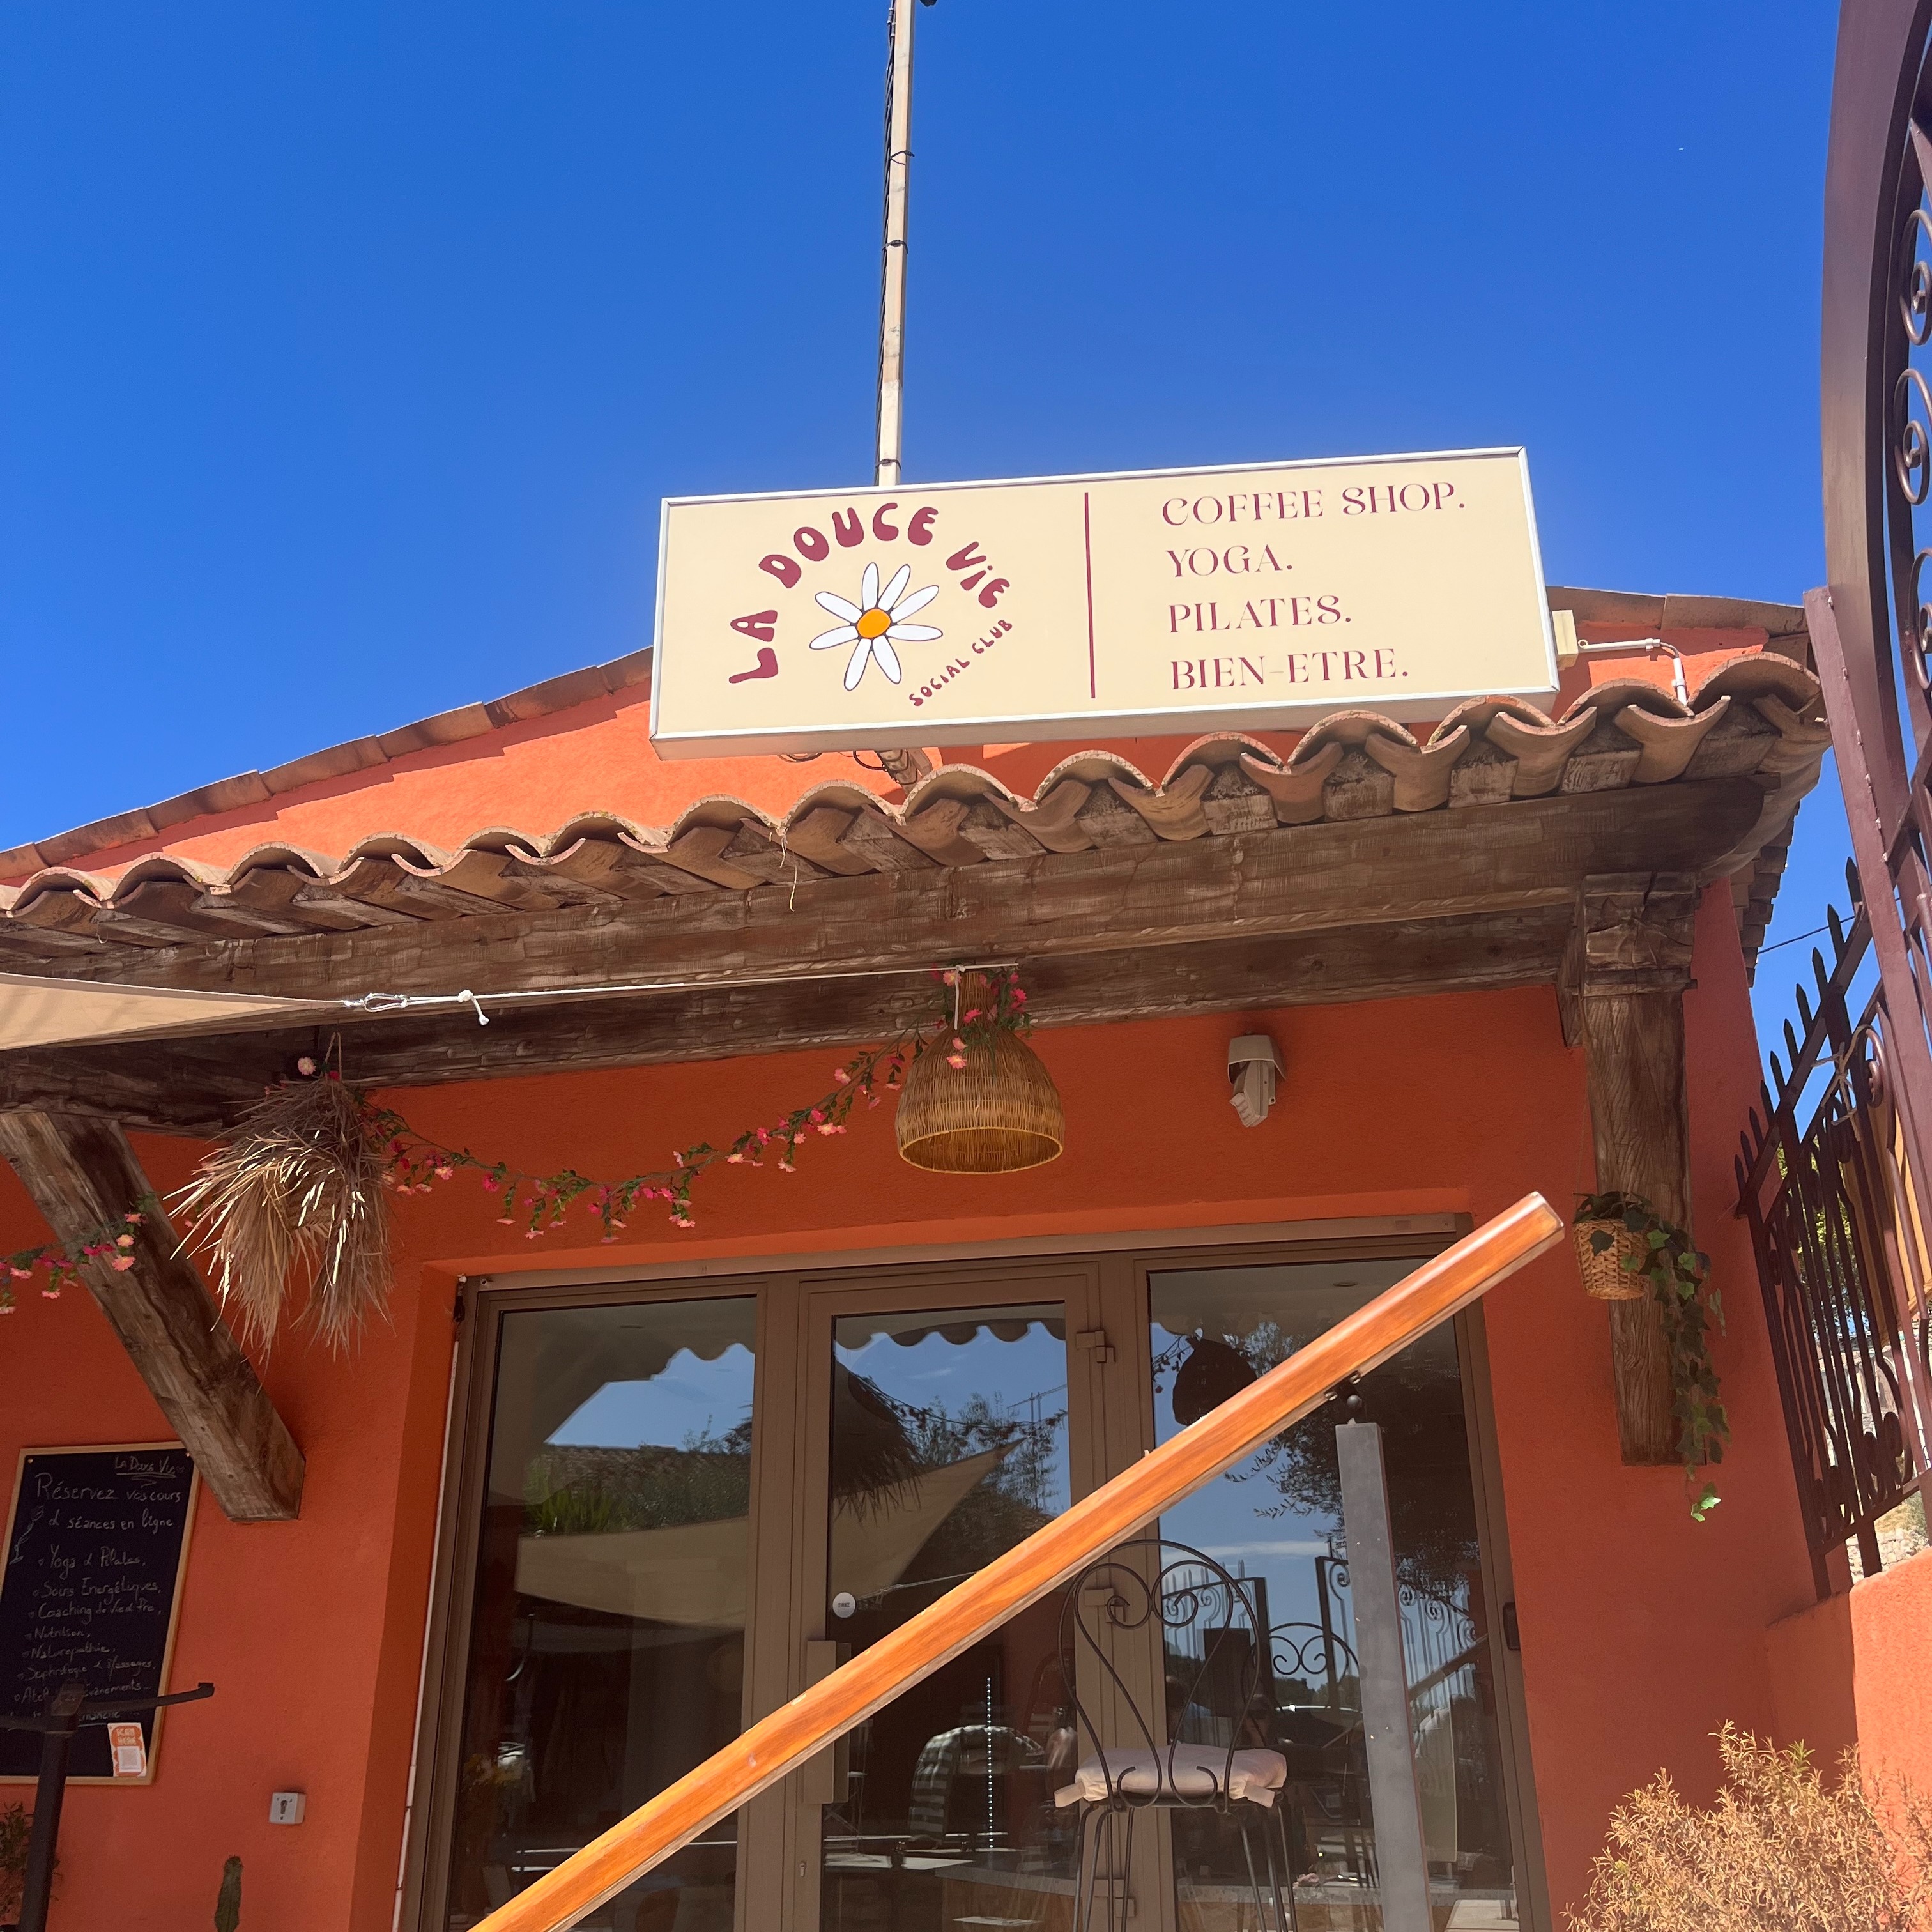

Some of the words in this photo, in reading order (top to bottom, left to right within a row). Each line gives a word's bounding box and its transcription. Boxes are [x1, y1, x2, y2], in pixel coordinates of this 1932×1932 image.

[1163, 490, 1324, 526] COFFEE
[1342, 482, 1465, 515] SHOP.
[1165, 544, 1293, 578] YOGA.
[729, 610, 778, 684] LA
[759, 503, 939, 588] DOUCE
[1169, 595, 1351, 633] PILATES.
[909, 659, 970, 706] SOCIAL
[972, 620, 1012, 654] CLUB
[1171, 648, 1408, 690] BIEN-ETRE.
[34, 1472, 118, 1500] Réservez
[127, 1491, 149, 1501] vos
[151, 1490, 181, 1502] cours
[66, 1517, 115, 1529] séances
[141, 1508, 174, 1534] ligne
[50, 1544, 76, 1581] Yoga
[38, 1602, 93, 1625] Coaching
